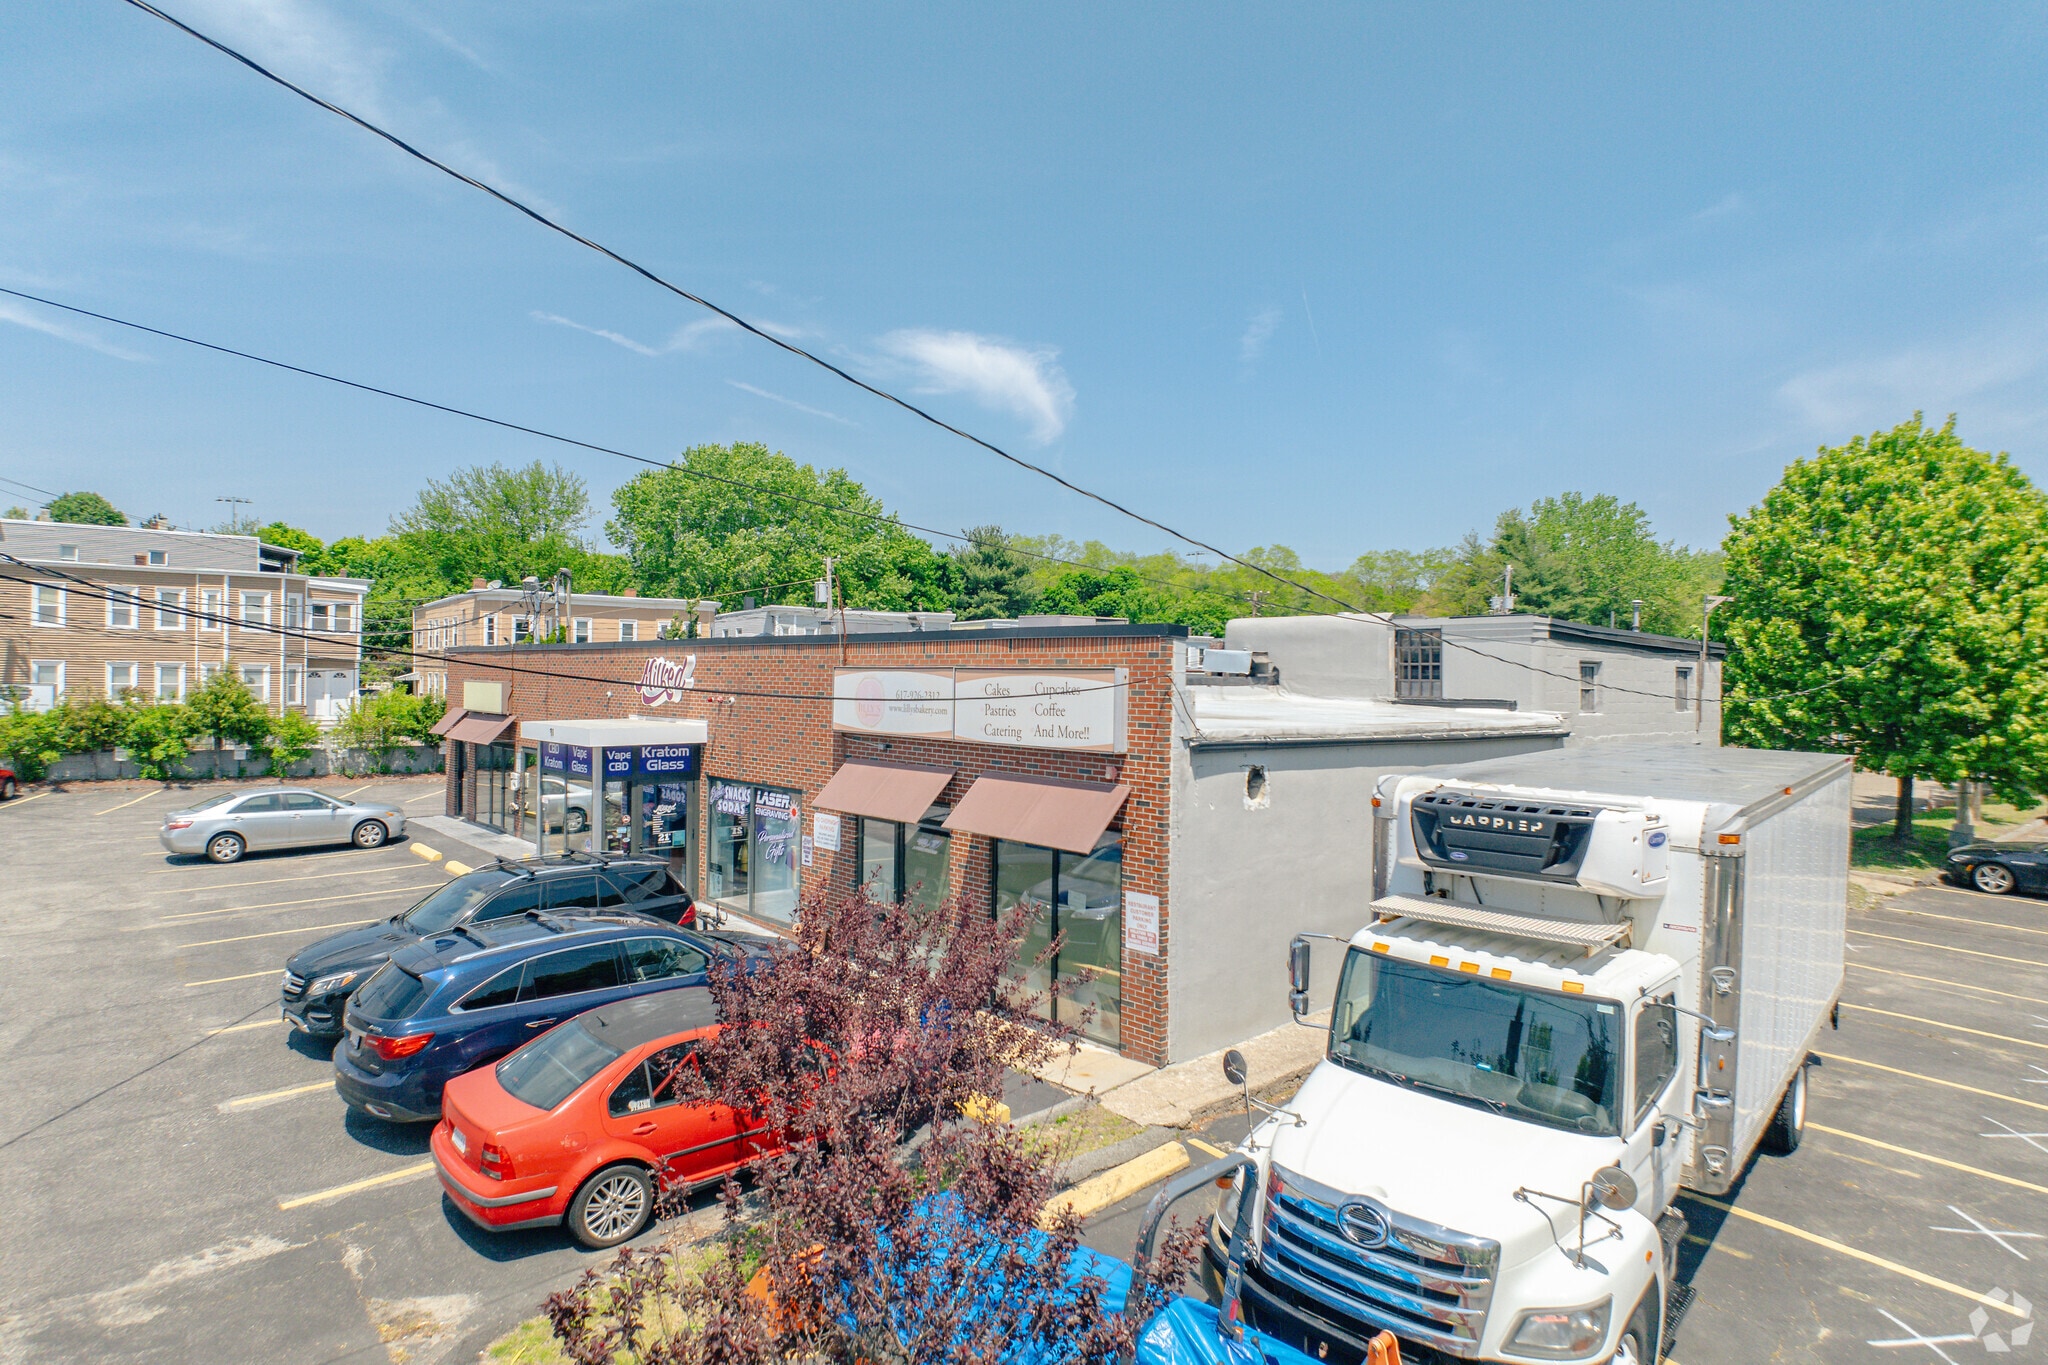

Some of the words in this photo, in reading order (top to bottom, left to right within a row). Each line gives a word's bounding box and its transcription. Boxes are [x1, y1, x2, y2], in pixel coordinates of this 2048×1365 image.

[635, 655, 694, 706] Milked
[984, 683, 1011, 696] Cakes
[1034, 681, 1081, 699] Cupcakes
[984, 703, 1017, 717] Pastries
[1034, 702, 1066, 717] Coffee
[984, 723, 1022, 741] Catering
[1033, 724, 1055, 738] And
[1057, 725, 1090, 740] More!!
[548, 744, 560, 754] CBD
[572, 746, 588, 759] Vape
[606, 750, 632, 761] Vape
[641, 746, 690, 758] Kratom
[544, 756, 563, 769] Kratom
[571, 760, 588, 774] Glass
[608, 762, 630, 772] CBD
[646, 759, 685, 771] Glass
[724, 785, 751, 805] SNACKS
[756, 790, 790, 809] LASER
[716, 798, 746, 816] SODAS
[755, 807, 788, 820] ENGRAVING
